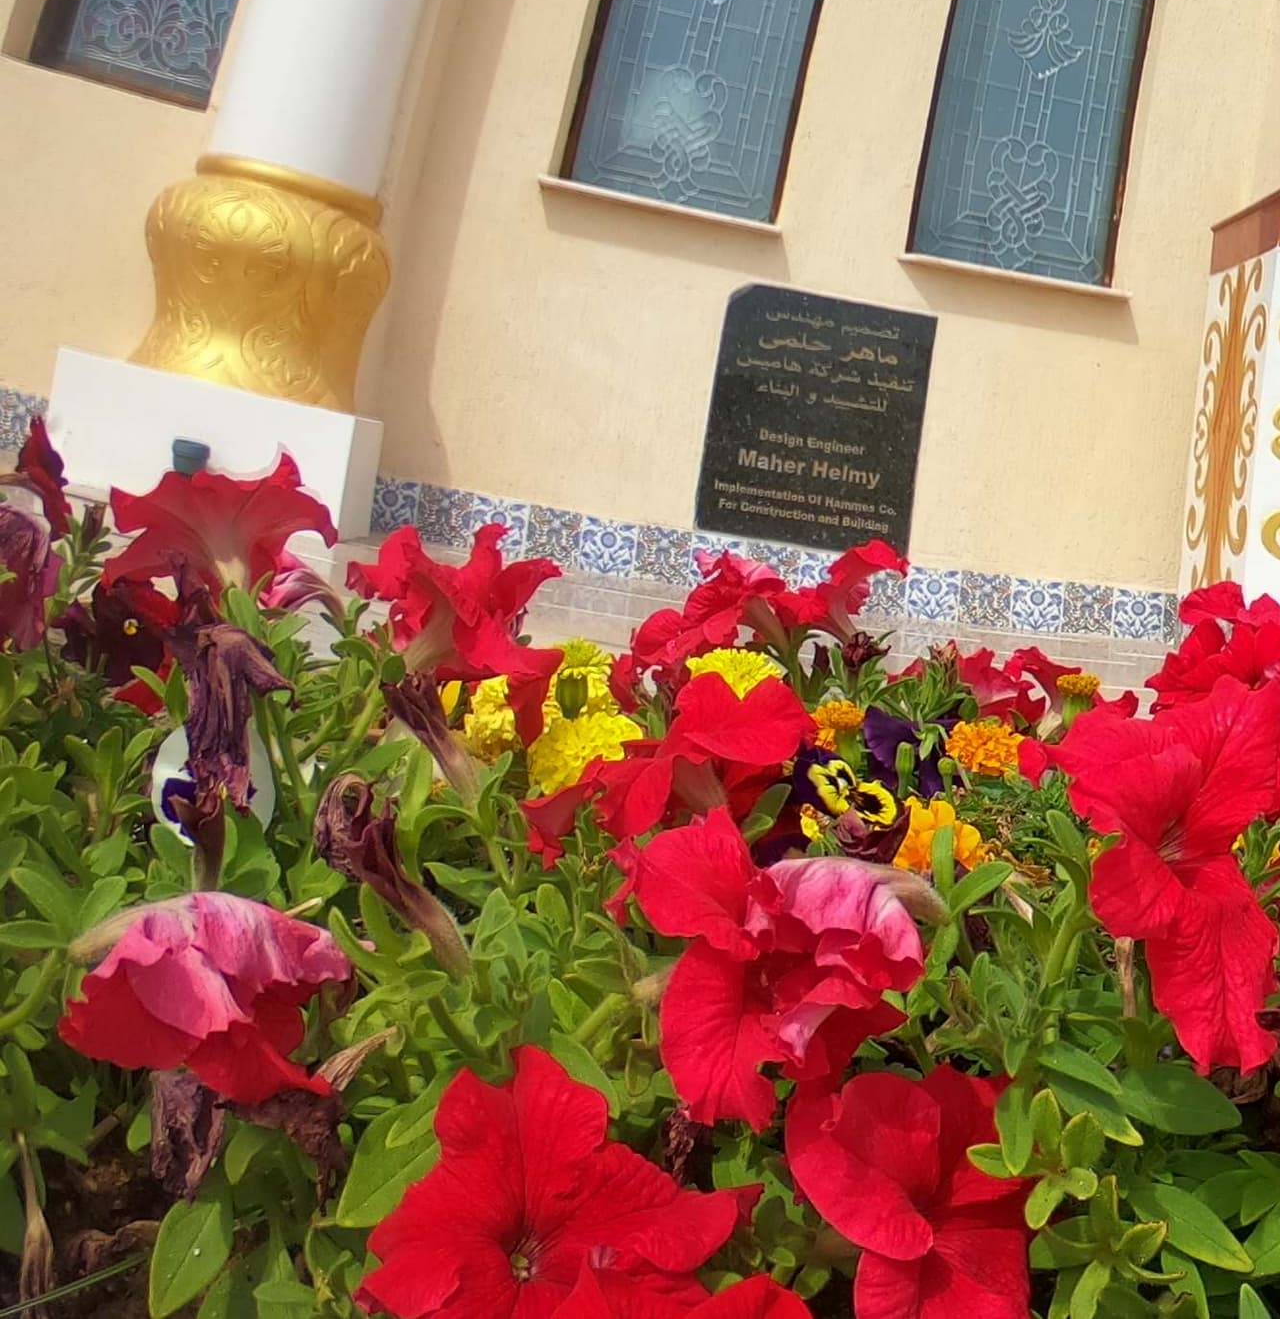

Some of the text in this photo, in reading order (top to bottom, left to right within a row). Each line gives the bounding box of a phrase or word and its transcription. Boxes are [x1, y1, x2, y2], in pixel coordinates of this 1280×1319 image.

[766, 310, 834, 329] مهندس
[839, 345, 898, 365] ماهر
[759, 428, 865, 456] Design Engineer
[738, 449, 880, 489] Maher Helmy
[714, 479, 805, 503] Implementation
[808, 494, 822, 506] Of
[718, 498, 889, 534] For Construction and Building
